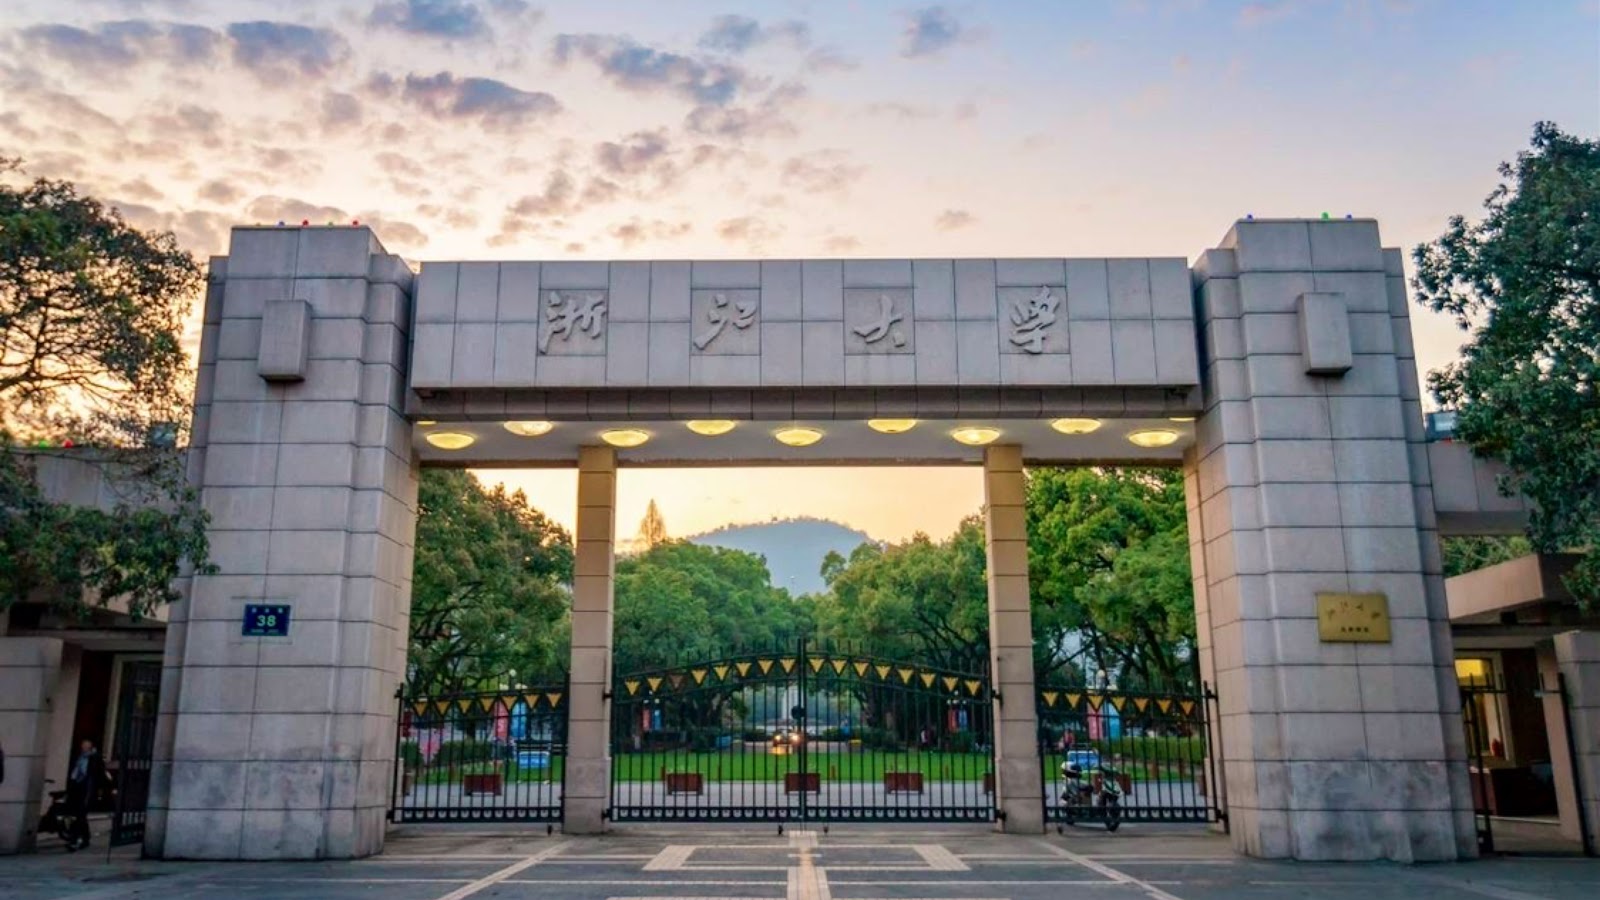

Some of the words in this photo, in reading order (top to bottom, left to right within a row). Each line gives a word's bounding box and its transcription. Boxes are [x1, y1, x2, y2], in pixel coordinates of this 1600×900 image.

[539, 285, 1061, 355] 浙江大学
[257, 615, 276, 627] 38
